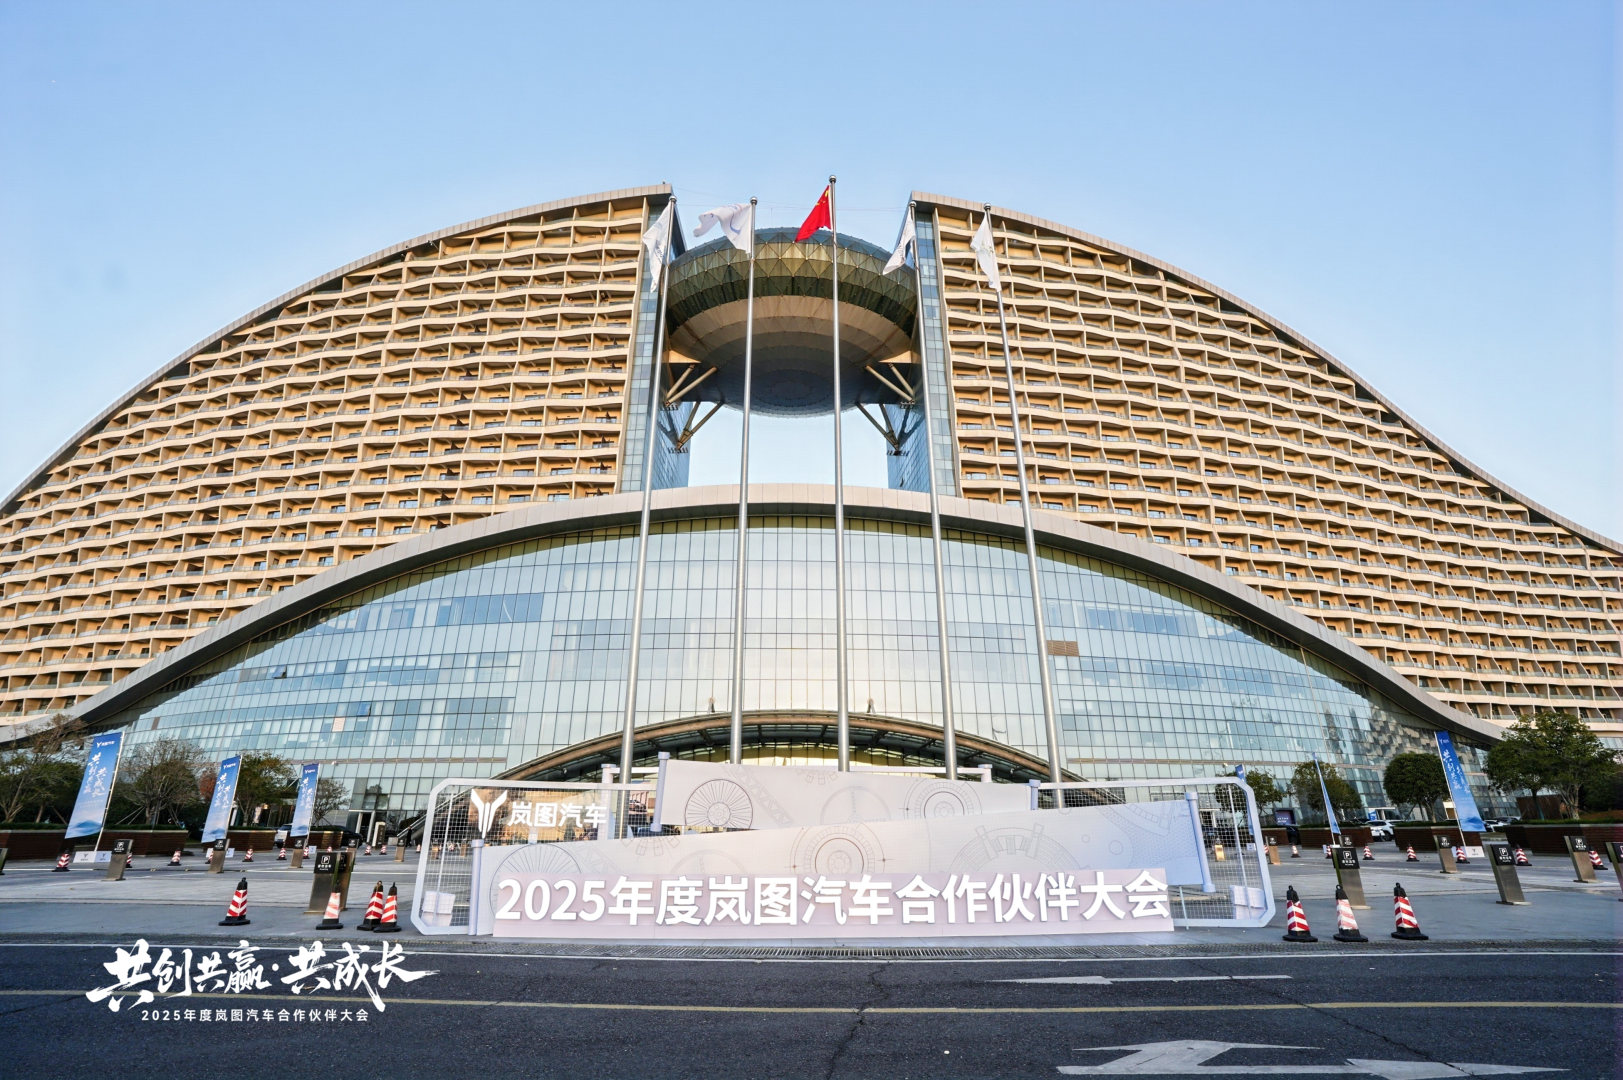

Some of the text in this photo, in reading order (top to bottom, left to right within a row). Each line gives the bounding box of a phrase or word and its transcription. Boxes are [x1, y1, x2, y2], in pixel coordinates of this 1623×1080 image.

[507, 801, 608, 828] 岚图汽车
[495, 870, 1170, 925] 2025年度岚图汽车合作伙伴大会
